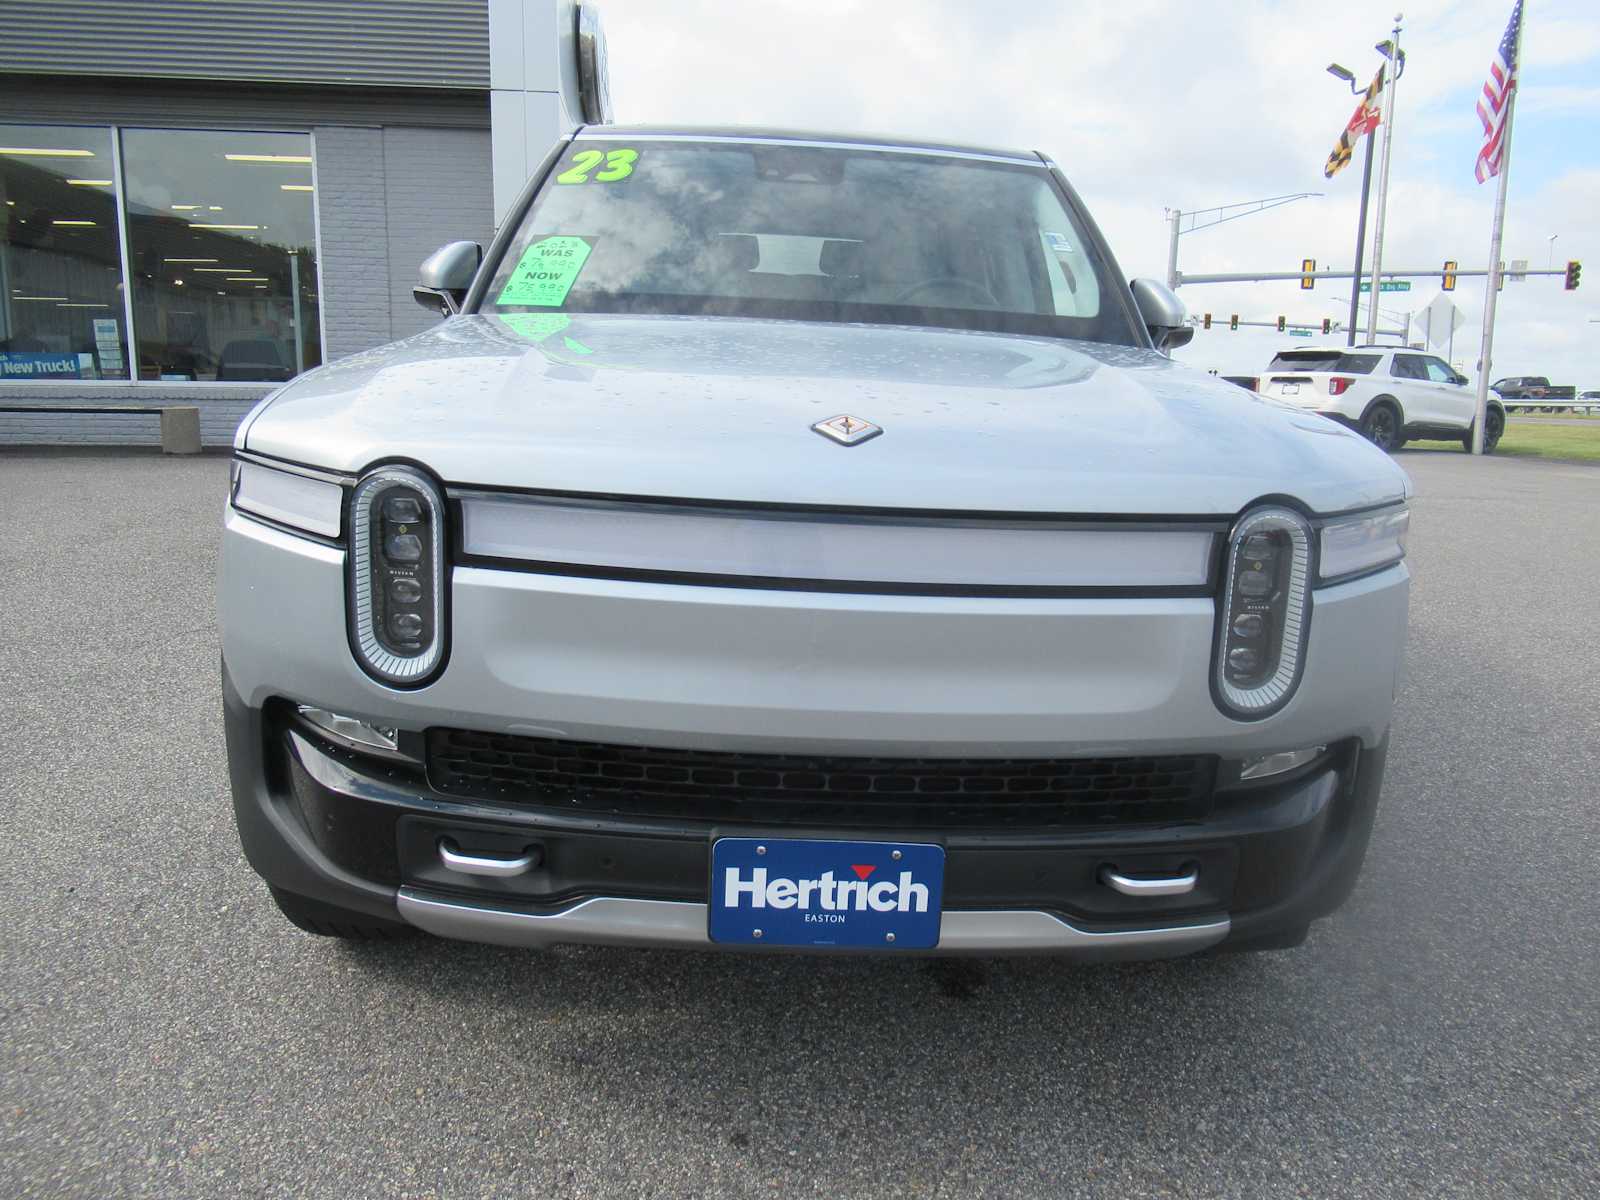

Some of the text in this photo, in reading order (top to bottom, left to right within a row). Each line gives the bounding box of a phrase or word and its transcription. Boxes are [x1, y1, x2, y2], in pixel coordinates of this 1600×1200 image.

[557, 148, 639, 184] 23
[540, 249, 575, 257] WAS
[524, 271, 563, 280] NOW
[3, 361, 33, 374] New
[34, 359, 76, 373] Truck!
[724, 867, 929, 913] Hertrich
[804, 913, 846, 924] EASTON
